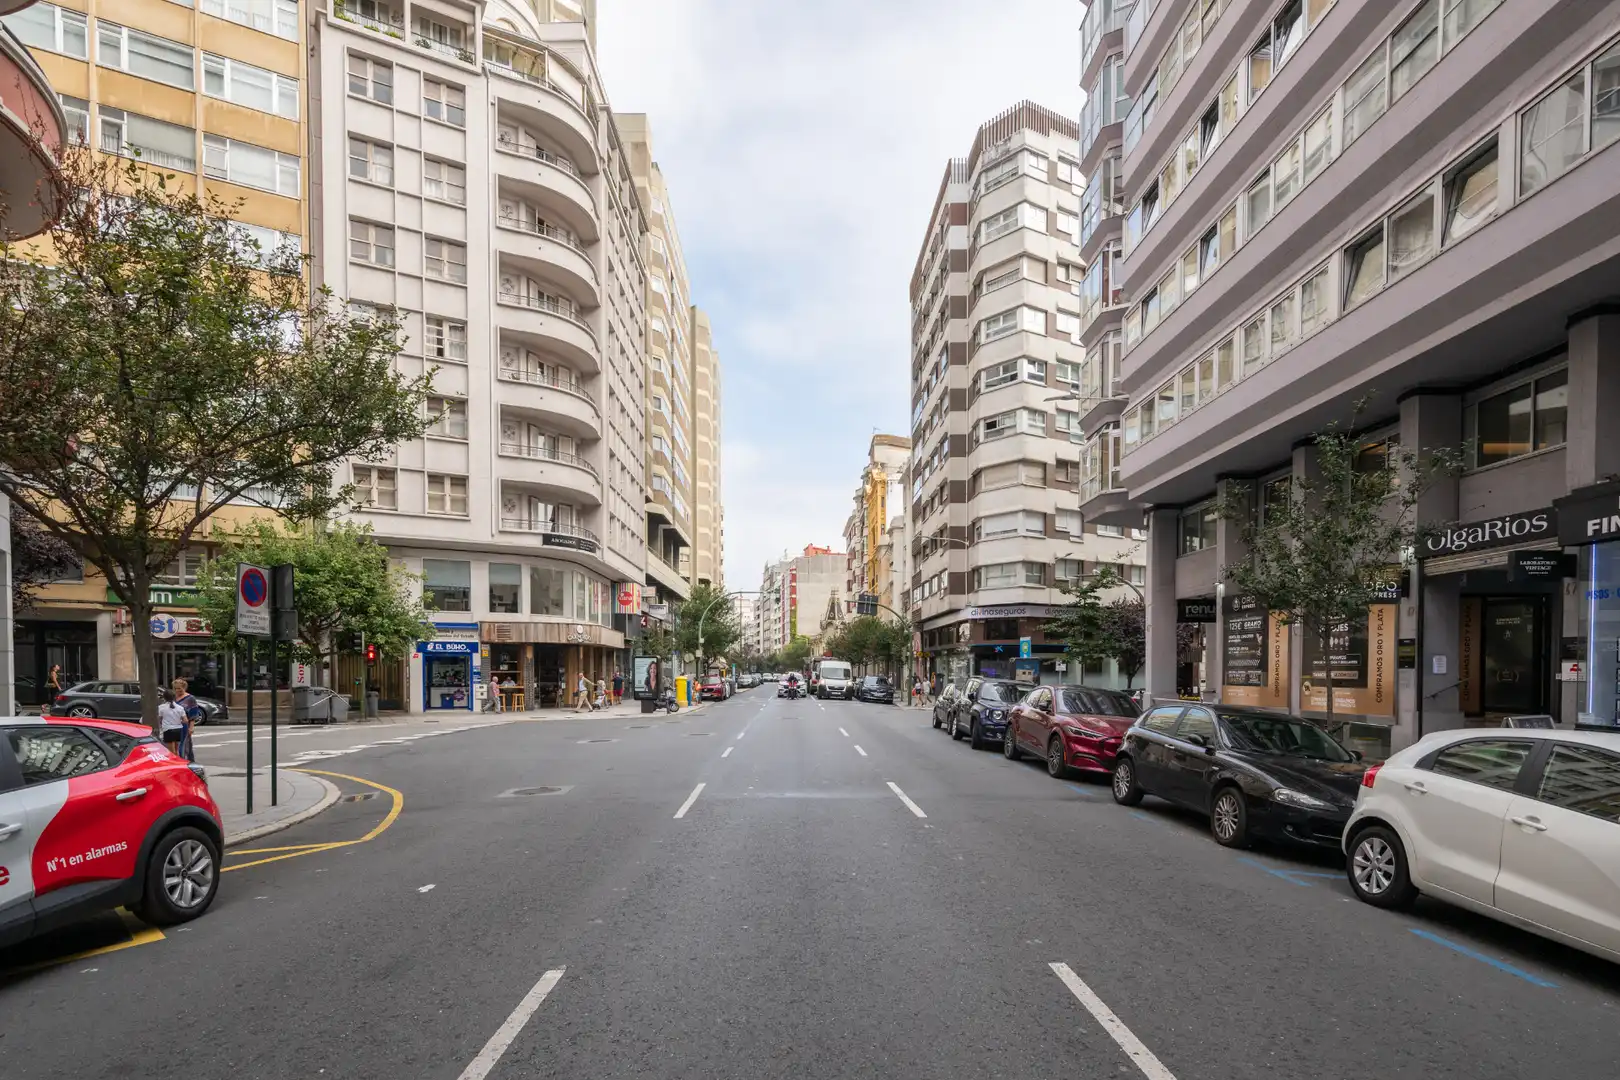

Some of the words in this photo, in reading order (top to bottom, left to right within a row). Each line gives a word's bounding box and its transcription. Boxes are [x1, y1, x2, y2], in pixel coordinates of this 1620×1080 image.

[1375, 654, 1384, 703] COMPRAMOS
[69, 854, 84, 866] en
[85, 840, 128, 861] alarmas
